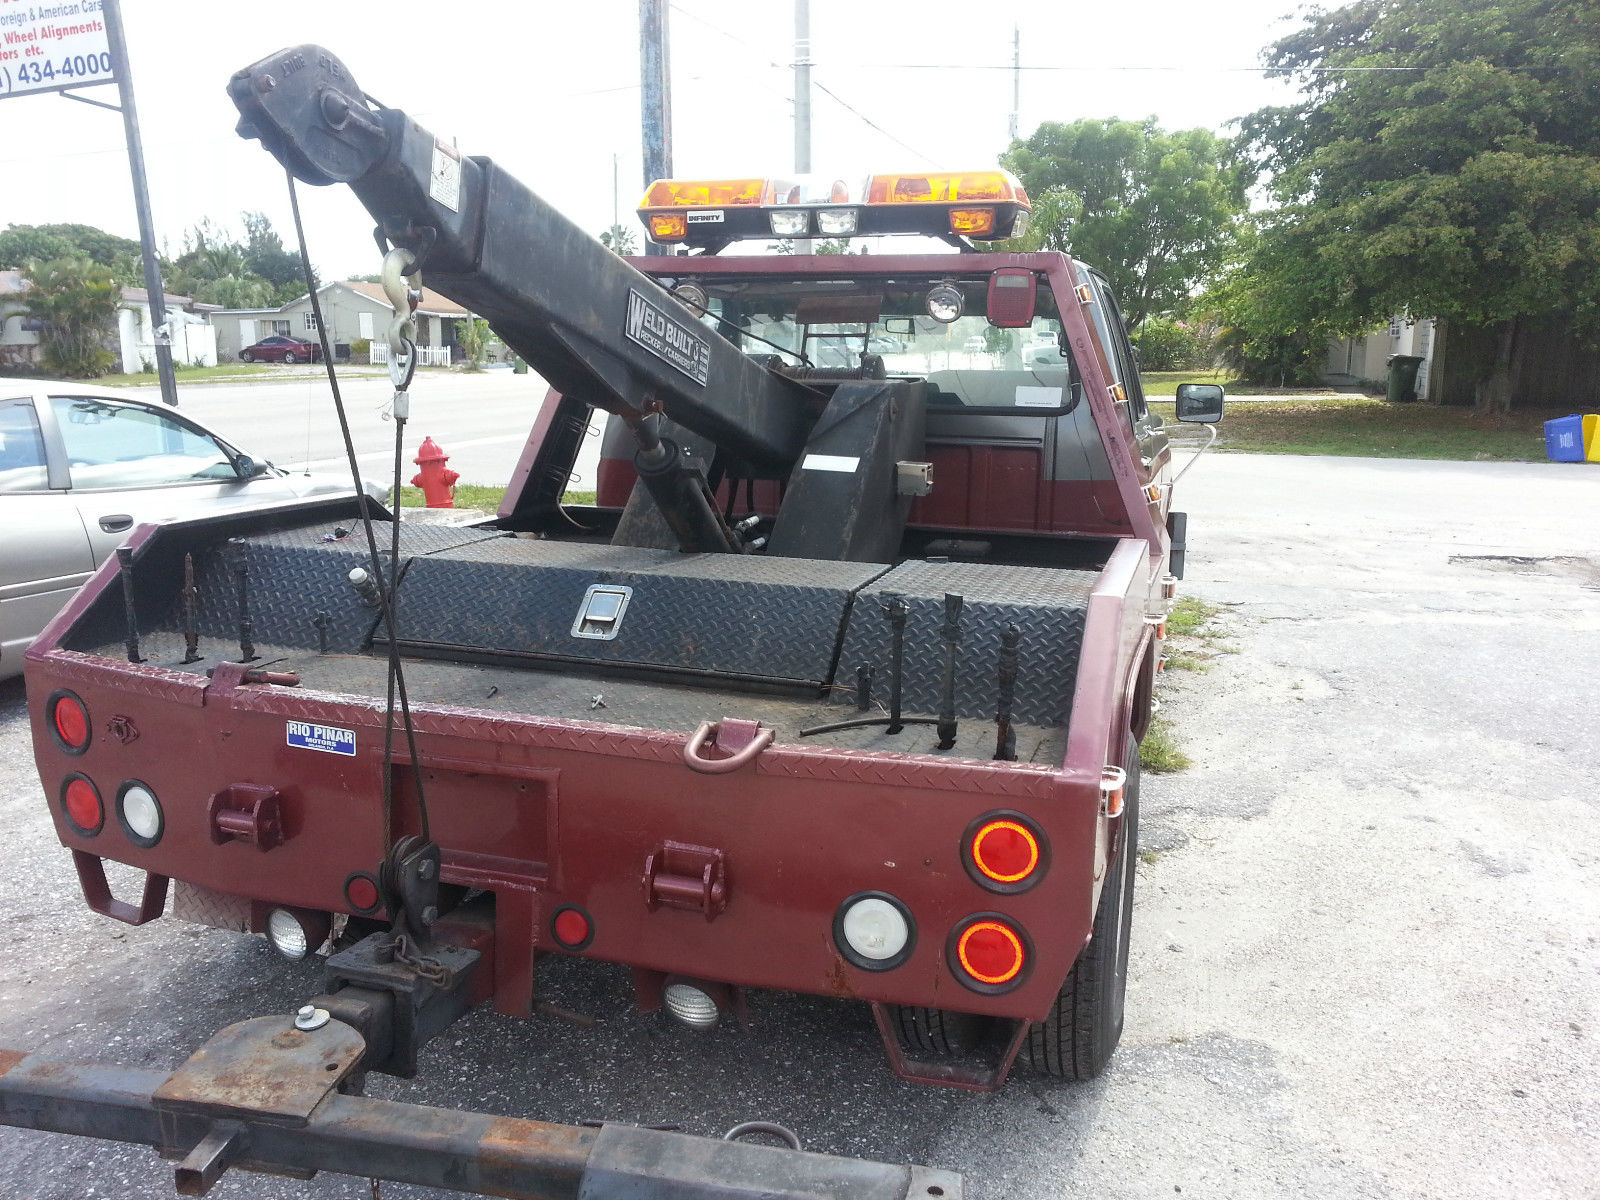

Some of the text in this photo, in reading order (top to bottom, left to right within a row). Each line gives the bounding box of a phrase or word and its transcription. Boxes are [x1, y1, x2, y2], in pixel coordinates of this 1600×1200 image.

[0, 0, 104, 27] oreign & American Cars
[4, 20, 103, 44] Wheel Alignments
[0, 44, 44, 61] tors etc.
[18, 52, 112, 84] 434-4000
[630, 293, 694, 356] WELD BUILT
[289, 722, 353, 744] RIO PINAR
[305, 737, 337, 747] MOTORS
